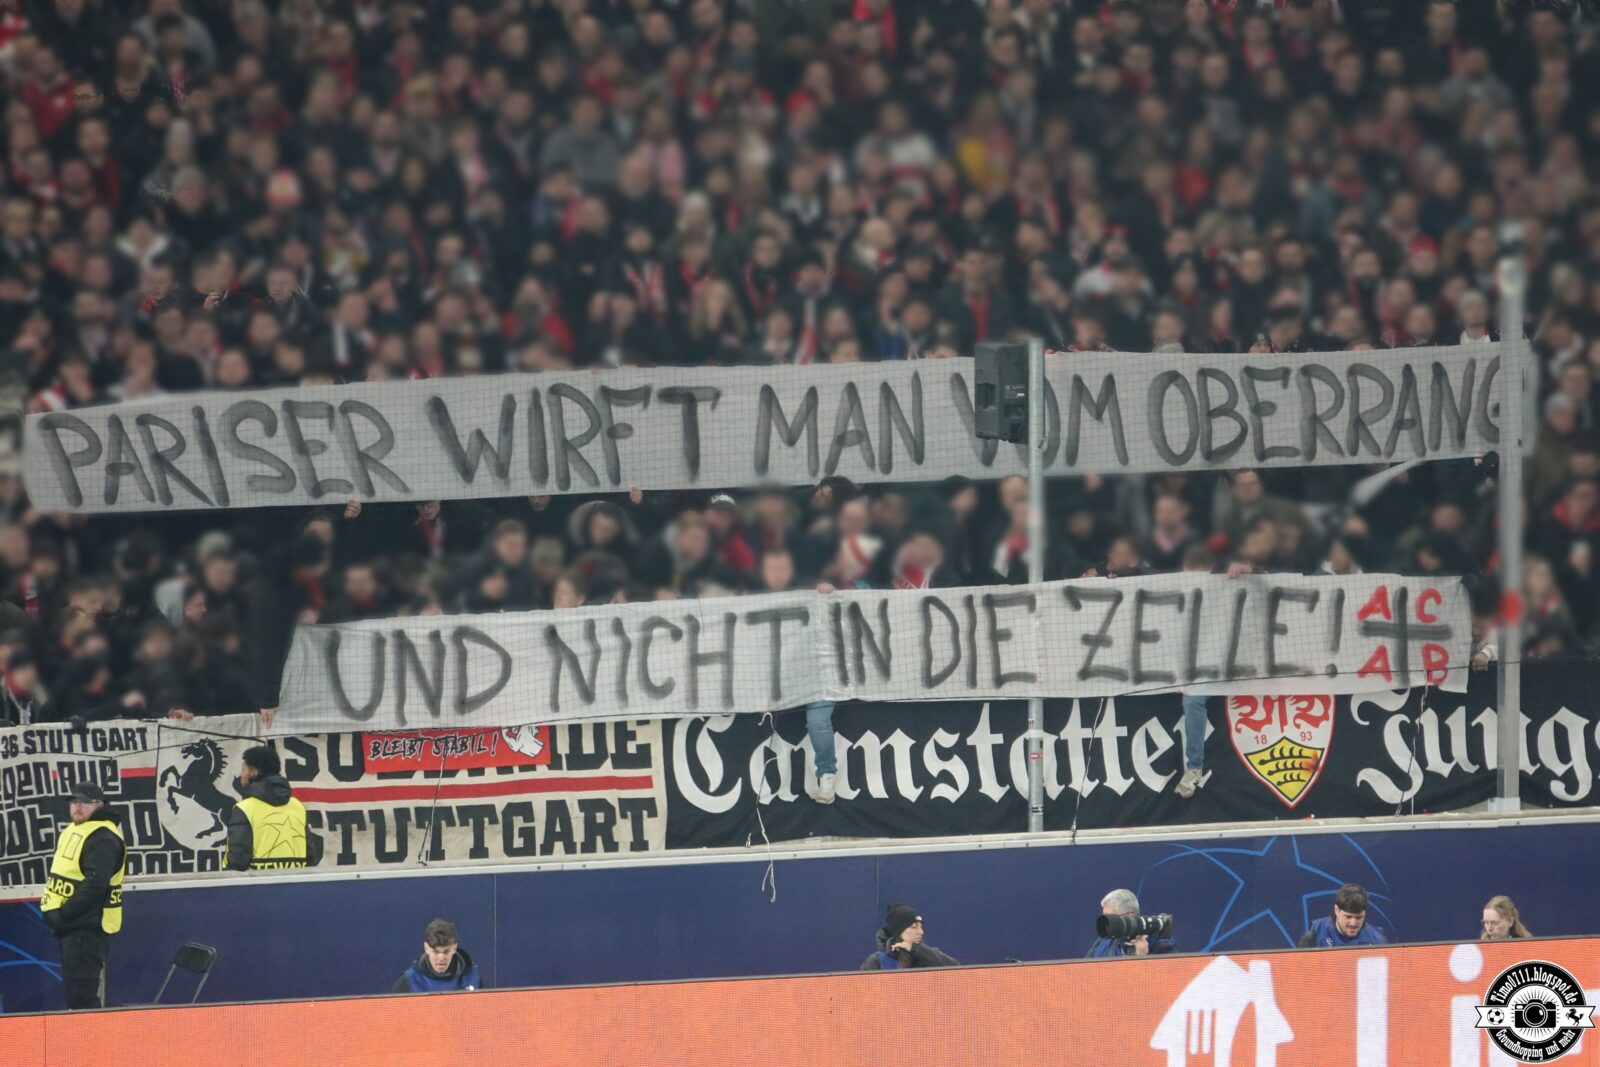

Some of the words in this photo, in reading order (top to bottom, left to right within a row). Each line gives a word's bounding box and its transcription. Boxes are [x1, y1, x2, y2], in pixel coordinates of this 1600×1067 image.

[38, 400, 410, 507] PARISER
[428, 382, 721, 491] WIRFT
[755, 371, 924, 477] MAN
[327, 624, 512, 726] UND
[545, 608, 809, 713] NICHT
[831, 598, 891, 689] IN
[921, 592, 1037, 689] DIE
[1064, 586, 1345, 685] ZELLE!
[23, 727, 147, 754] STUTTGART
[368, 736, 427, 762] BLEIBT
[1253, 734, 1268, 745] 18
[1300, 731, 1313, 742] 93
[1350, 687, 1600, 804] Jung
[47, 877, 75, 897] ARD
